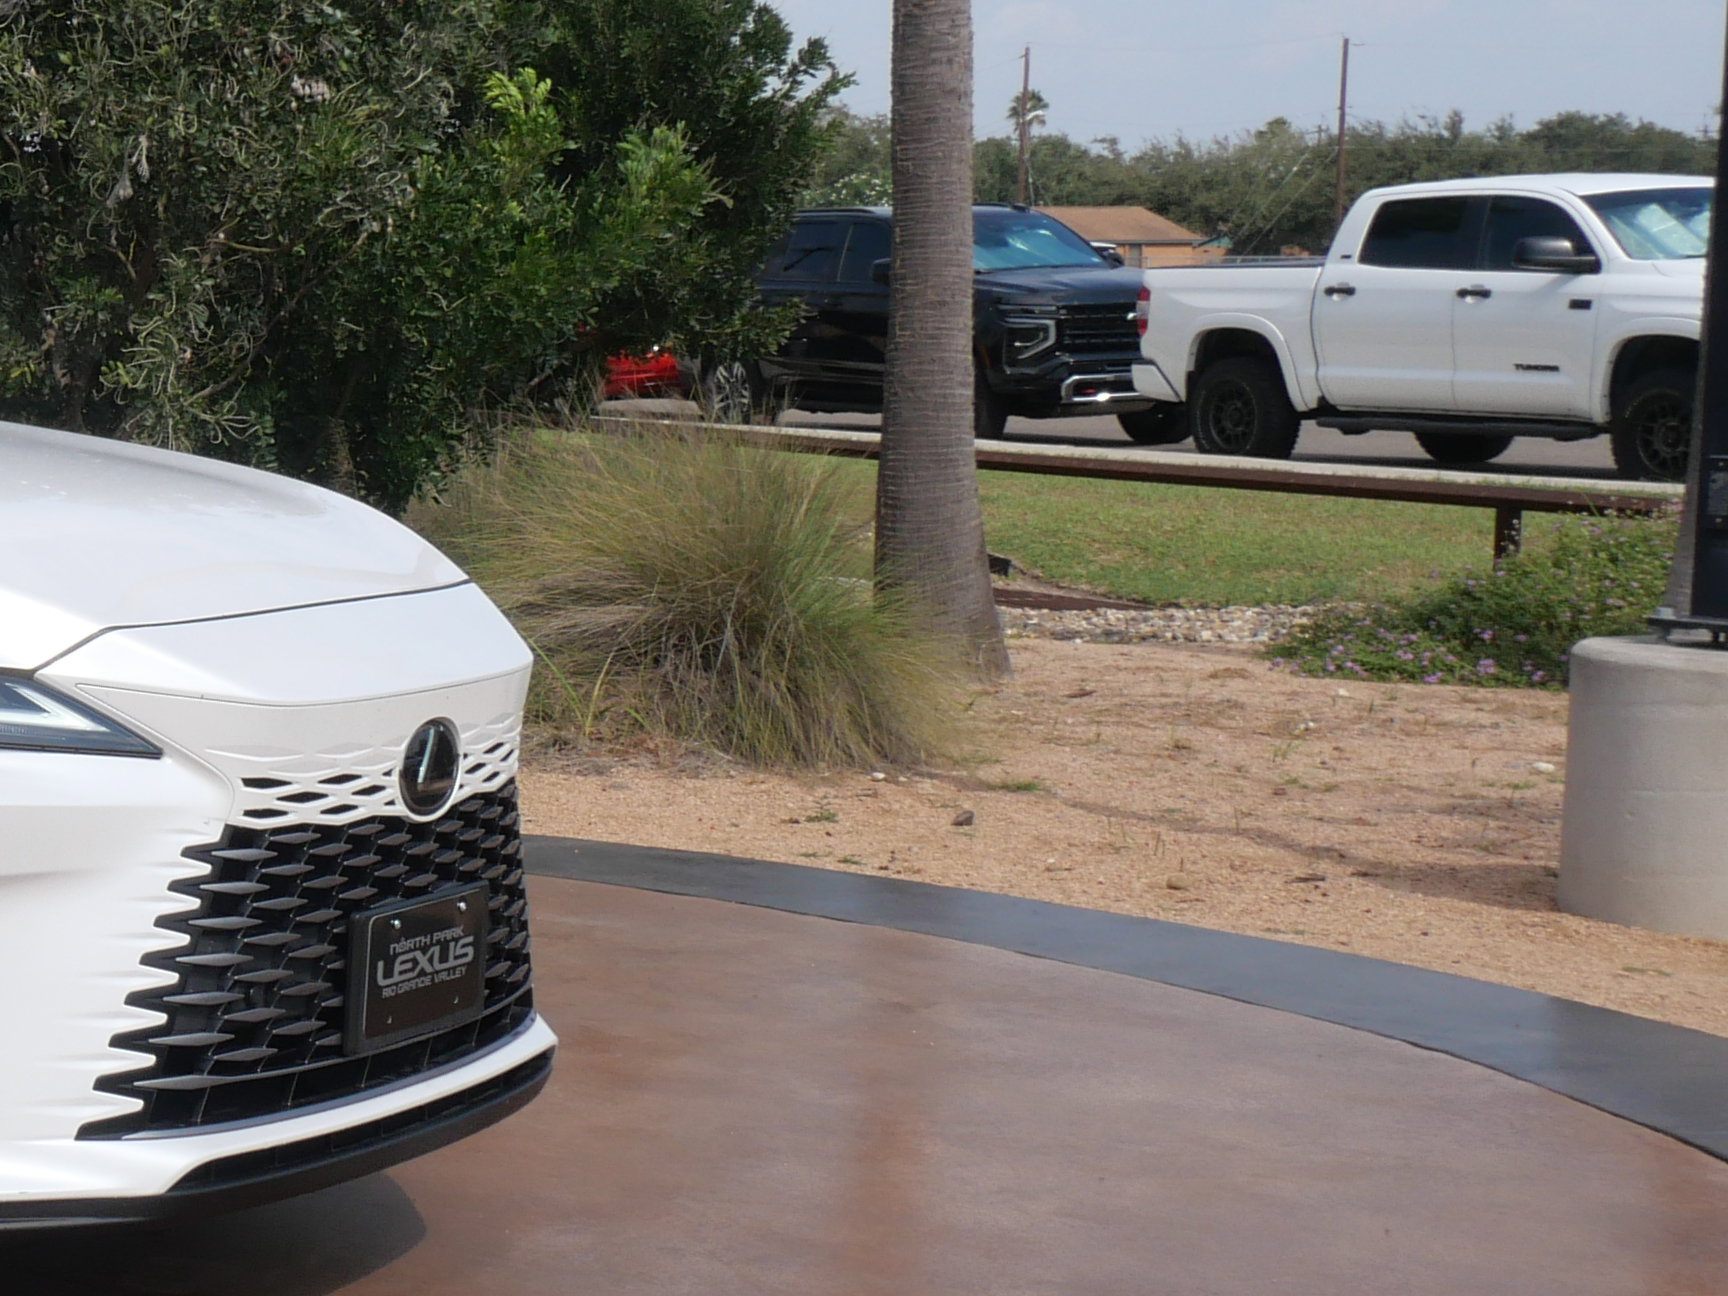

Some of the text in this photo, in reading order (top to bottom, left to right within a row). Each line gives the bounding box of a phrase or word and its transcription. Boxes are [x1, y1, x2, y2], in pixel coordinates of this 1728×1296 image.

[433, 925, 464, 944] PARK
[377, 935, 474, 987] LEXUS
[382, 965, 467, 999] RIO GRANDE VALLEY
